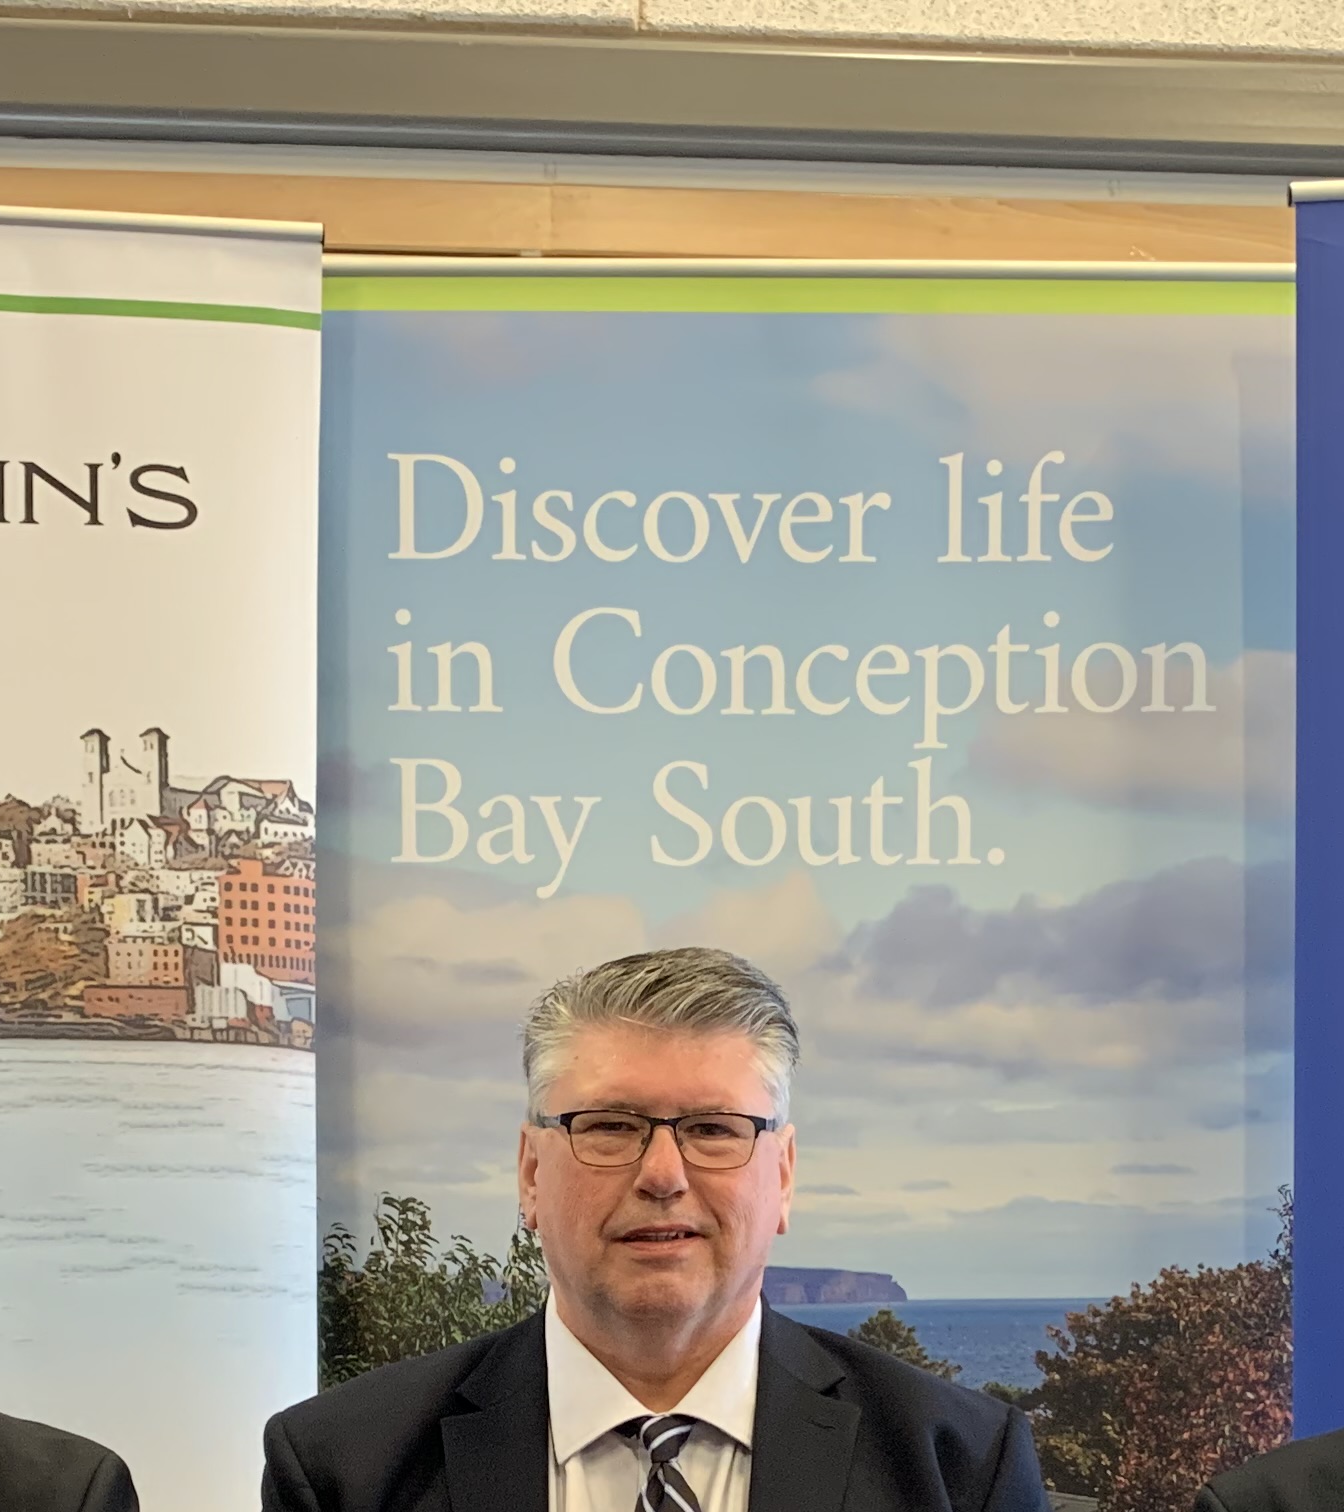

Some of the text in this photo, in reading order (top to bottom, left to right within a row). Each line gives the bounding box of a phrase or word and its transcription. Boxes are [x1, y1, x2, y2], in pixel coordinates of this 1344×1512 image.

[386, 449, 1114, 563] Discover life
[386, 606, 1217, 749] in Conception
[390, 756, 1006, 899] Bay South.
